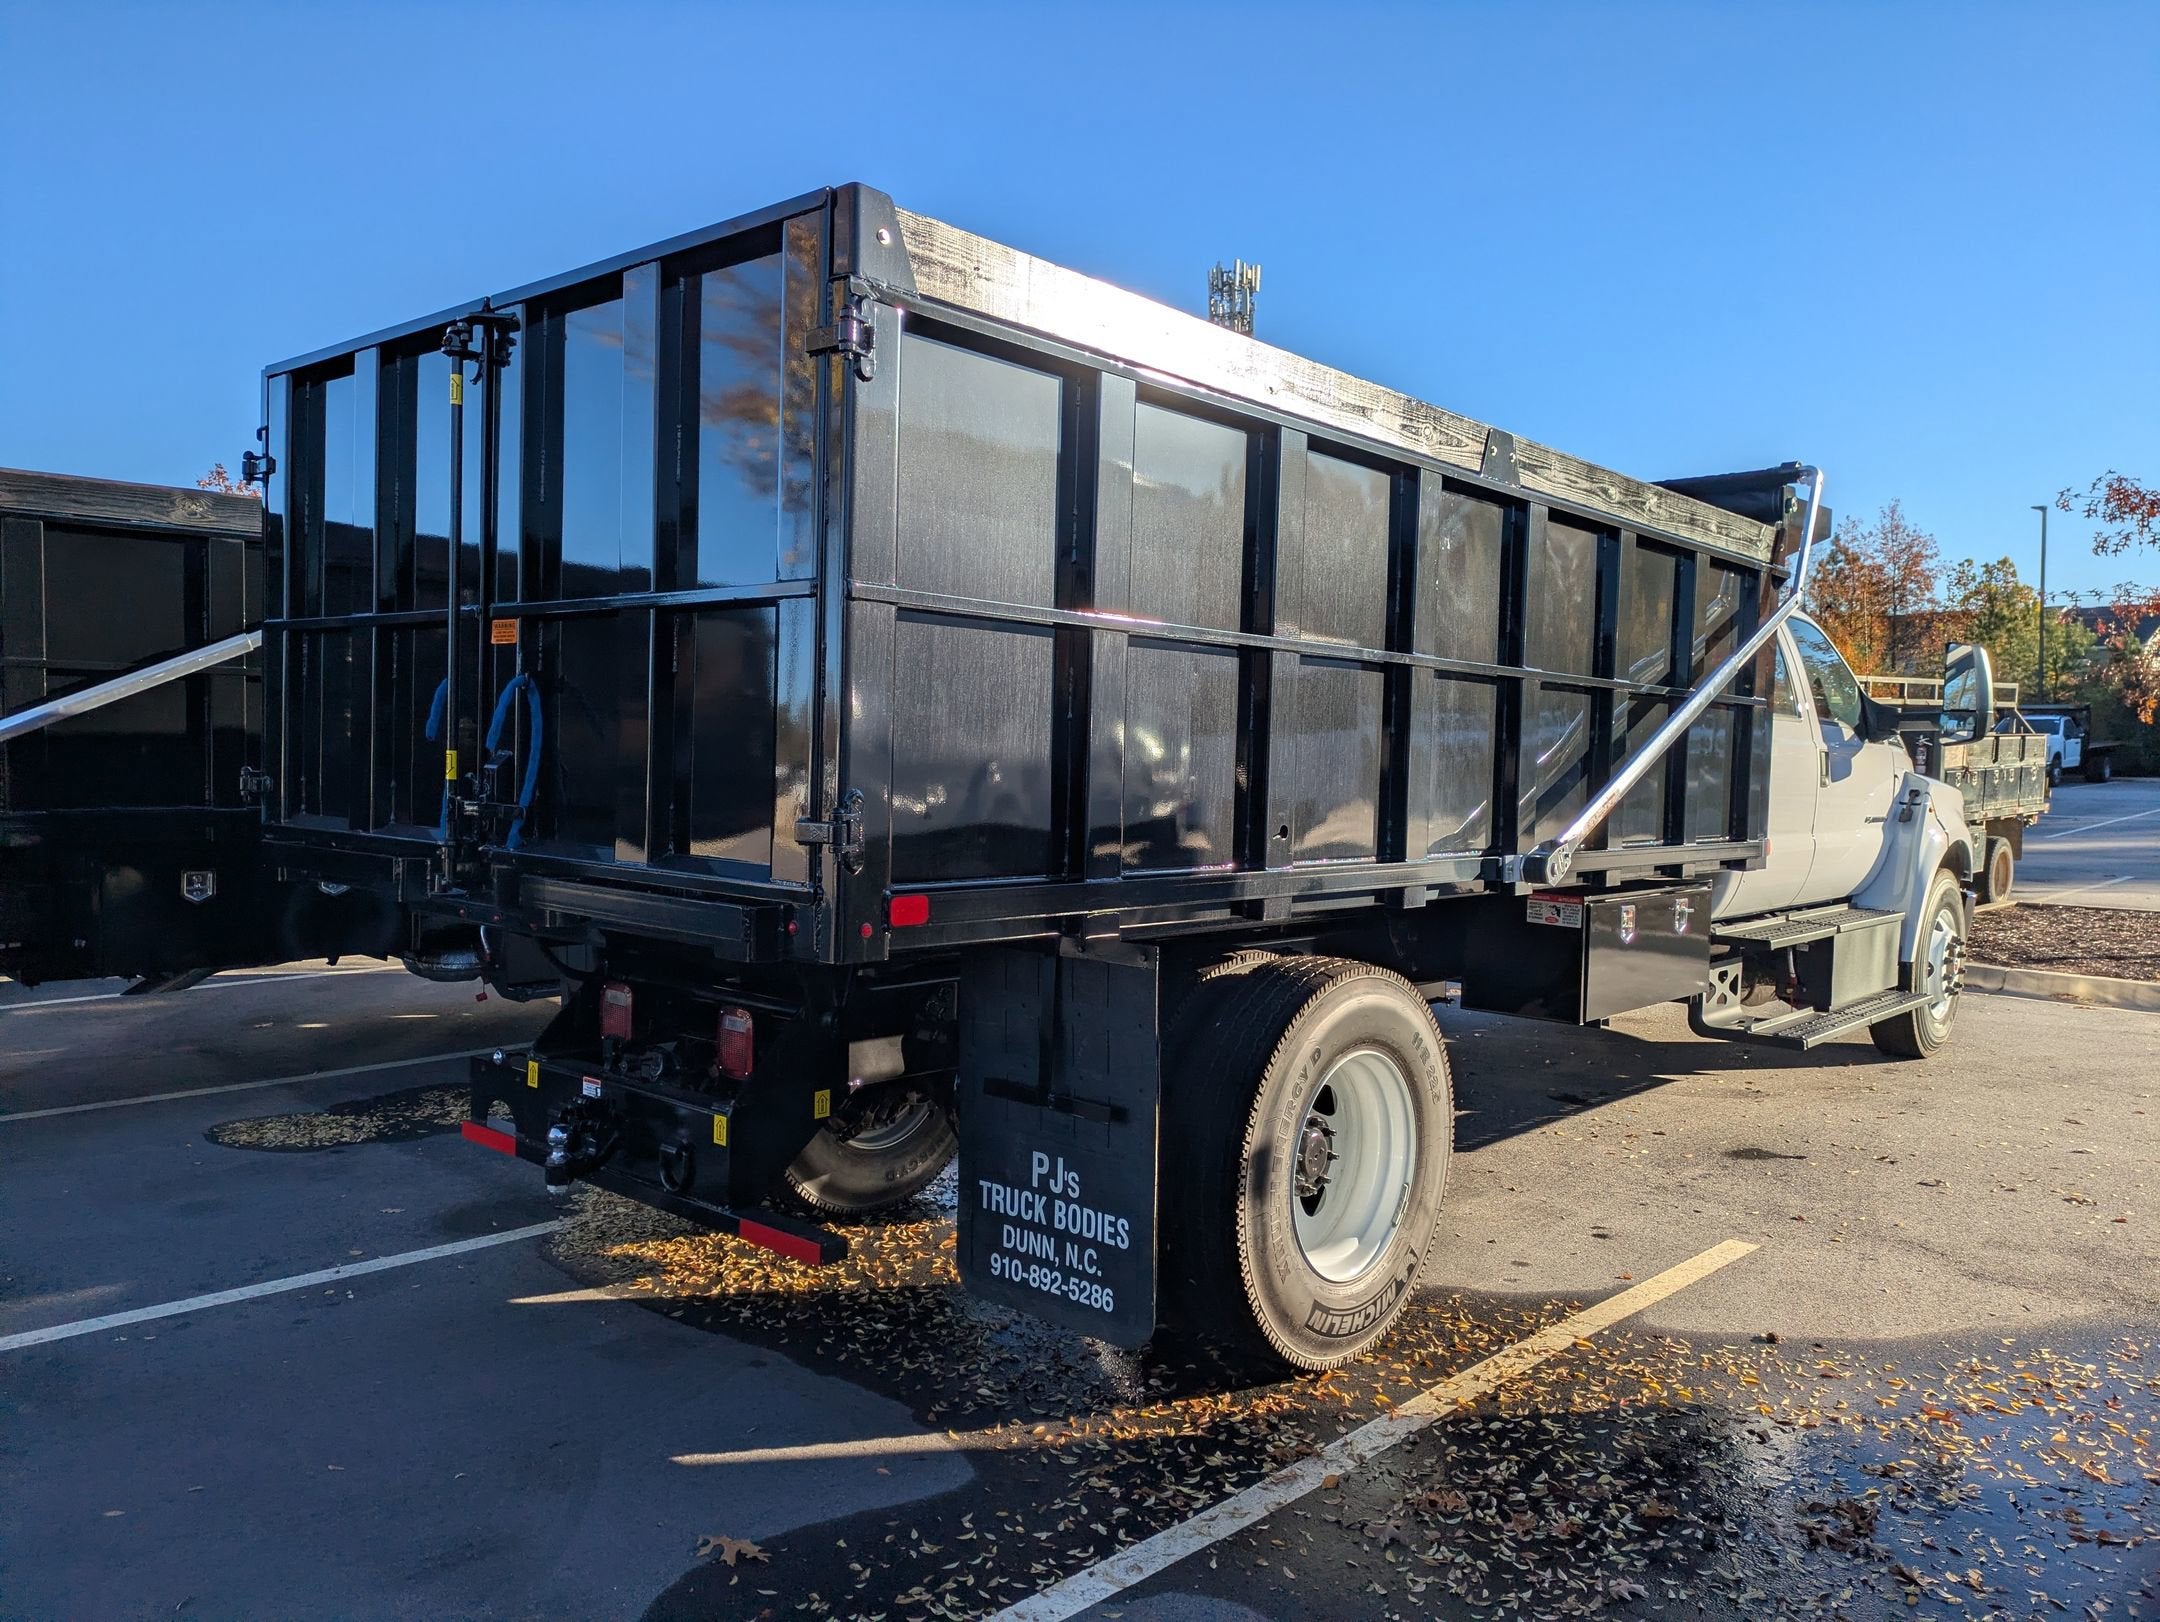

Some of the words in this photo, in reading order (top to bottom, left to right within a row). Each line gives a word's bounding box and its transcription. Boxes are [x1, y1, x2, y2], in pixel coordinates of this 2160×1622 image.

[978, 1179, 1048, 1226] TRUCK
[1053, 1199, 1131, 1250] BODIES
[1002, 1223, 1060, 1268] DUNN,
[1065, 1241, 1103, 1277] N.C.
[989, 1252, 1115, 1313] 910-892-5286
[1307, 1279, 1397, 1335] MICHELIN
